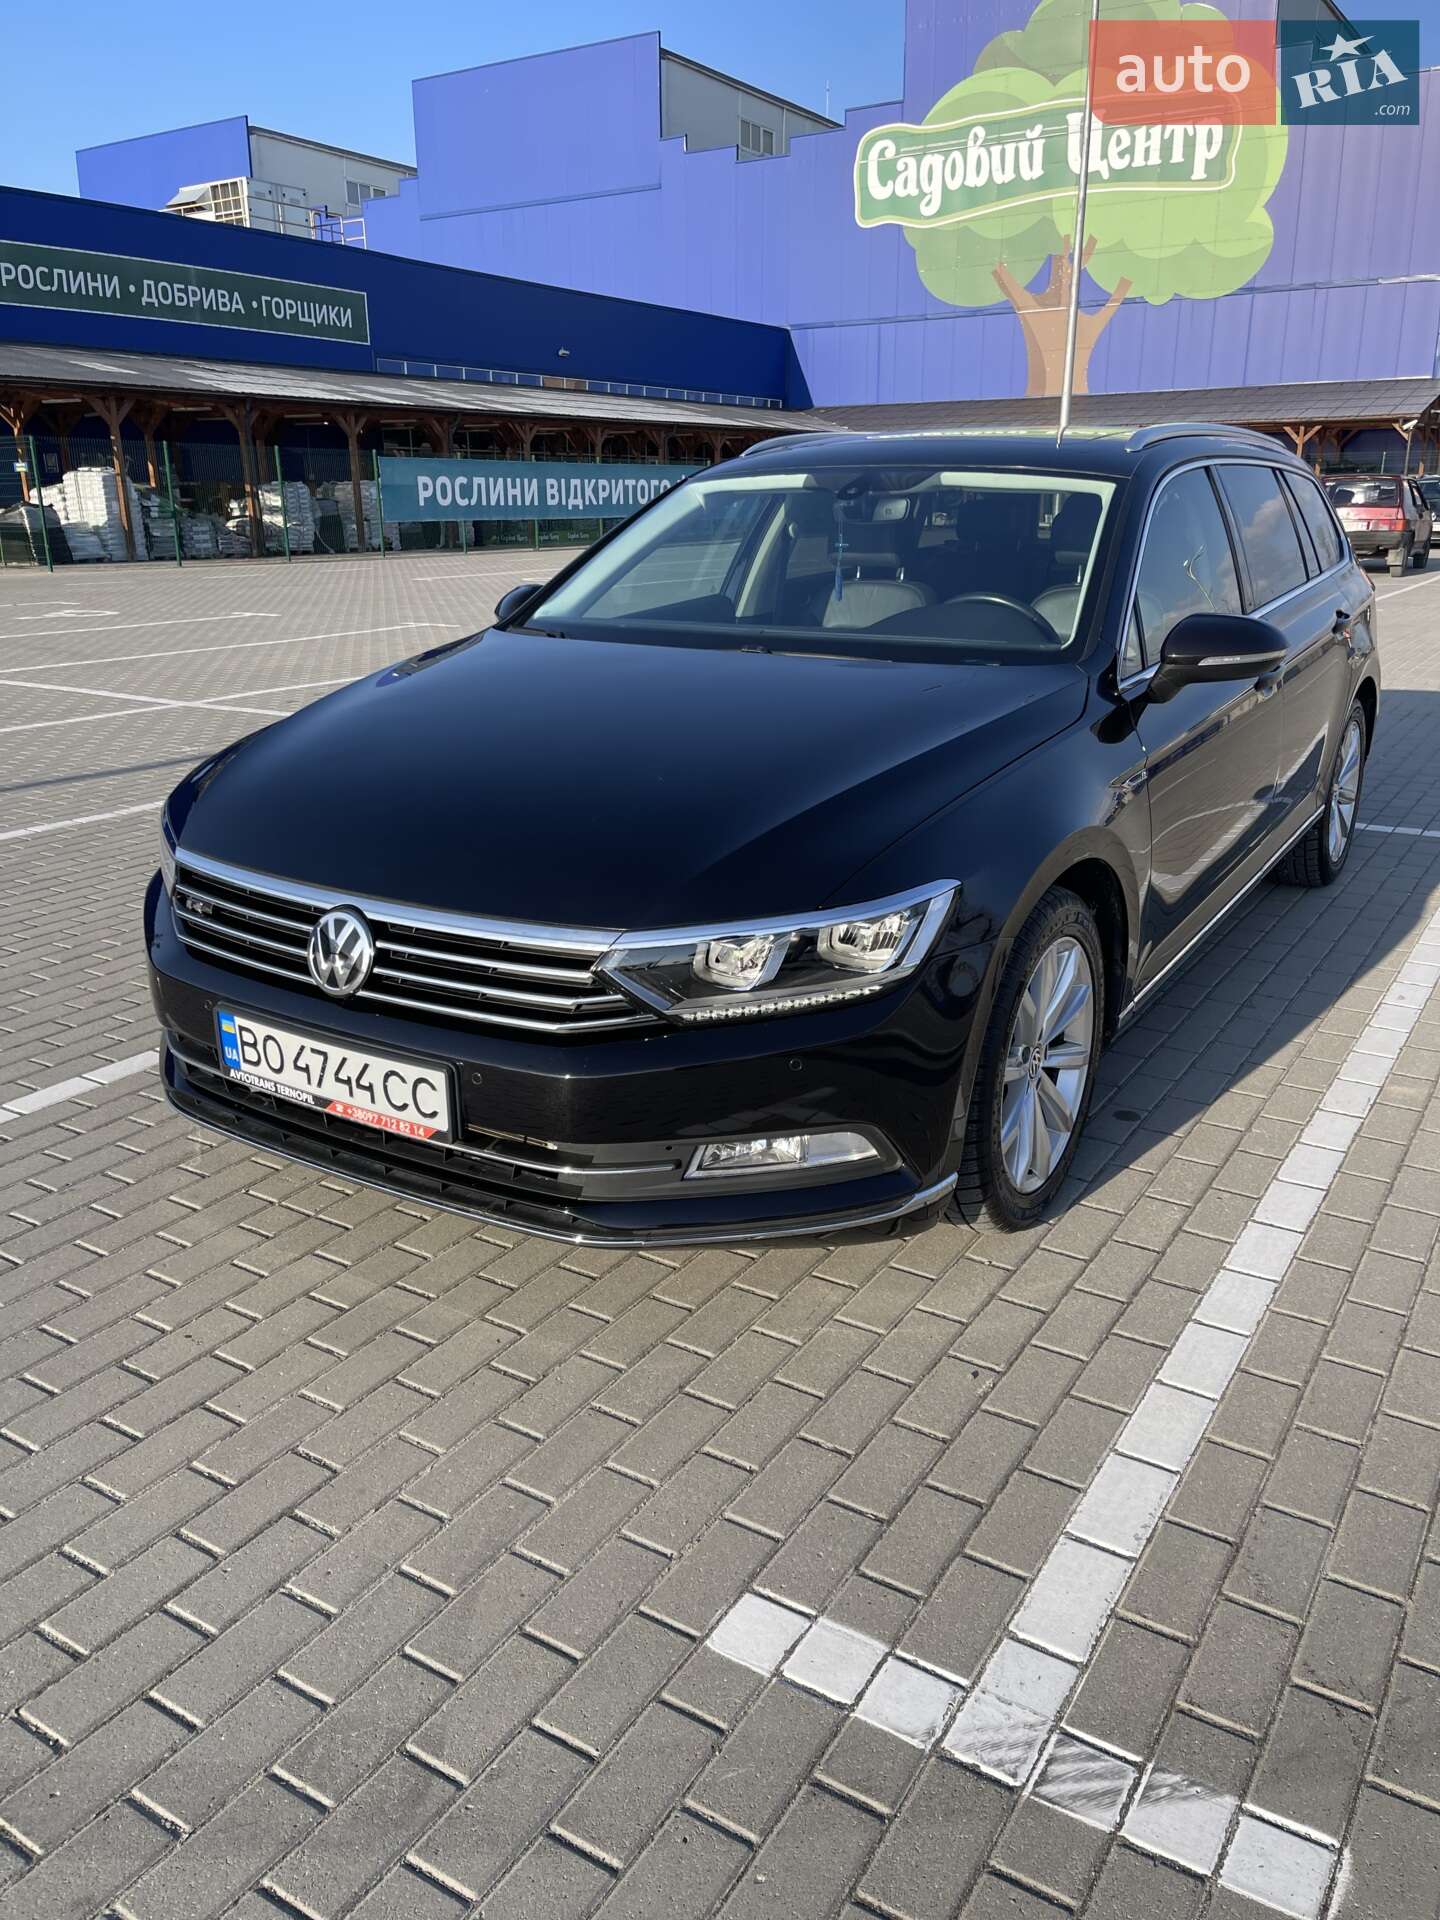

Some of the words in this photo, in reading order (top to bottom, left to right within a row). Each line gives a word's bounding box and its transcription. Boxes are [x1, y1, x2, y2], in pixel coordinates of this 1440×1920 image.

[867, 122, 1046, 217] Садовий
[1065, 109, 1224, 180] Центр
[1, 262, 121, 299] РОСЛИНИ
[141, 280, 245, 314] ДОБРИВА
[261, 296, 353, 328] ГОРЩИКИ
[417, 475, 539, 507] РОСЛИНИ
[224, 1045, 240, 1062] UA
[293, 1045, 376, 1105] 4744
[229, 1068, 276, 1093] AVTOTRANS
[276, 1083, 315, 1105] TERNOPIL
